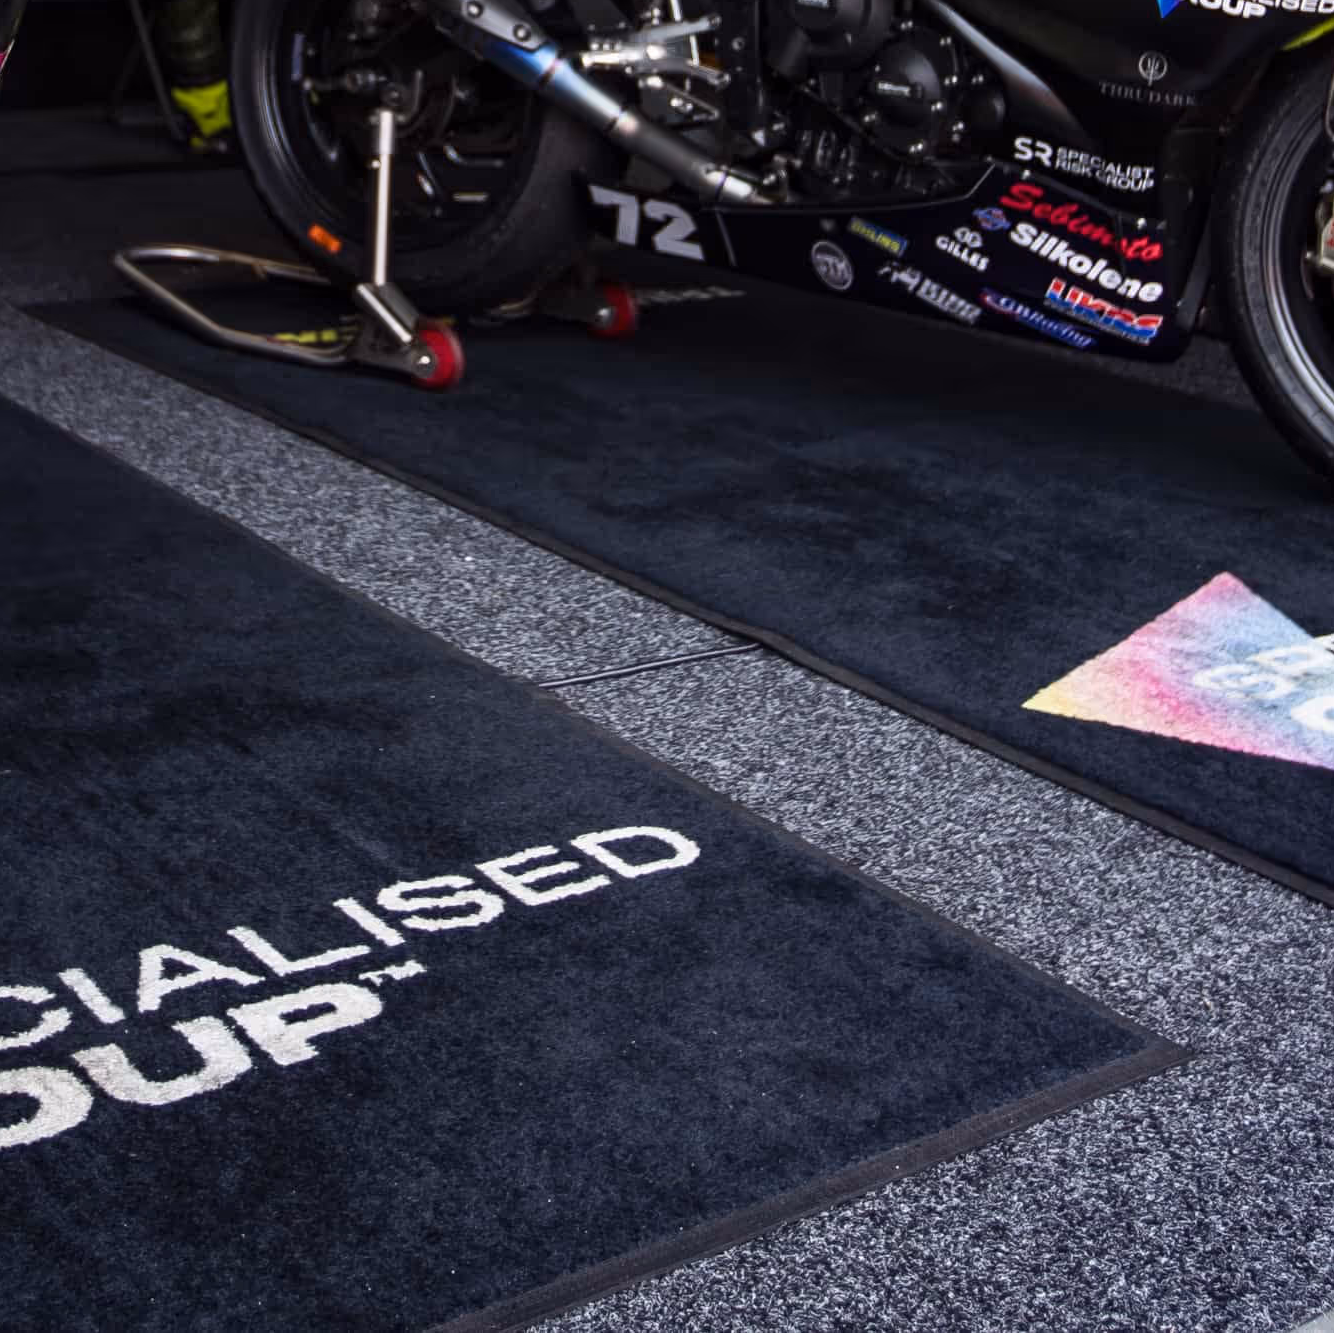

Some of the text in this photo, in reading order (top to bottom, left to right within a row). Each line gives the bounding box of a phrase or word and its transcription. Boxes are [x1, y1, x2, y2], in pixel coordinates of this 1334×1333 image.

[1098, 80, 1198, 107] THRUDARK
[1013, 135, 1156, 180] SR SPECIALIST
[587, 184, 707, 262] 72
[934, 234, 991, 273] GILLES
[1008, 221, 1164, 302] Silkolene
